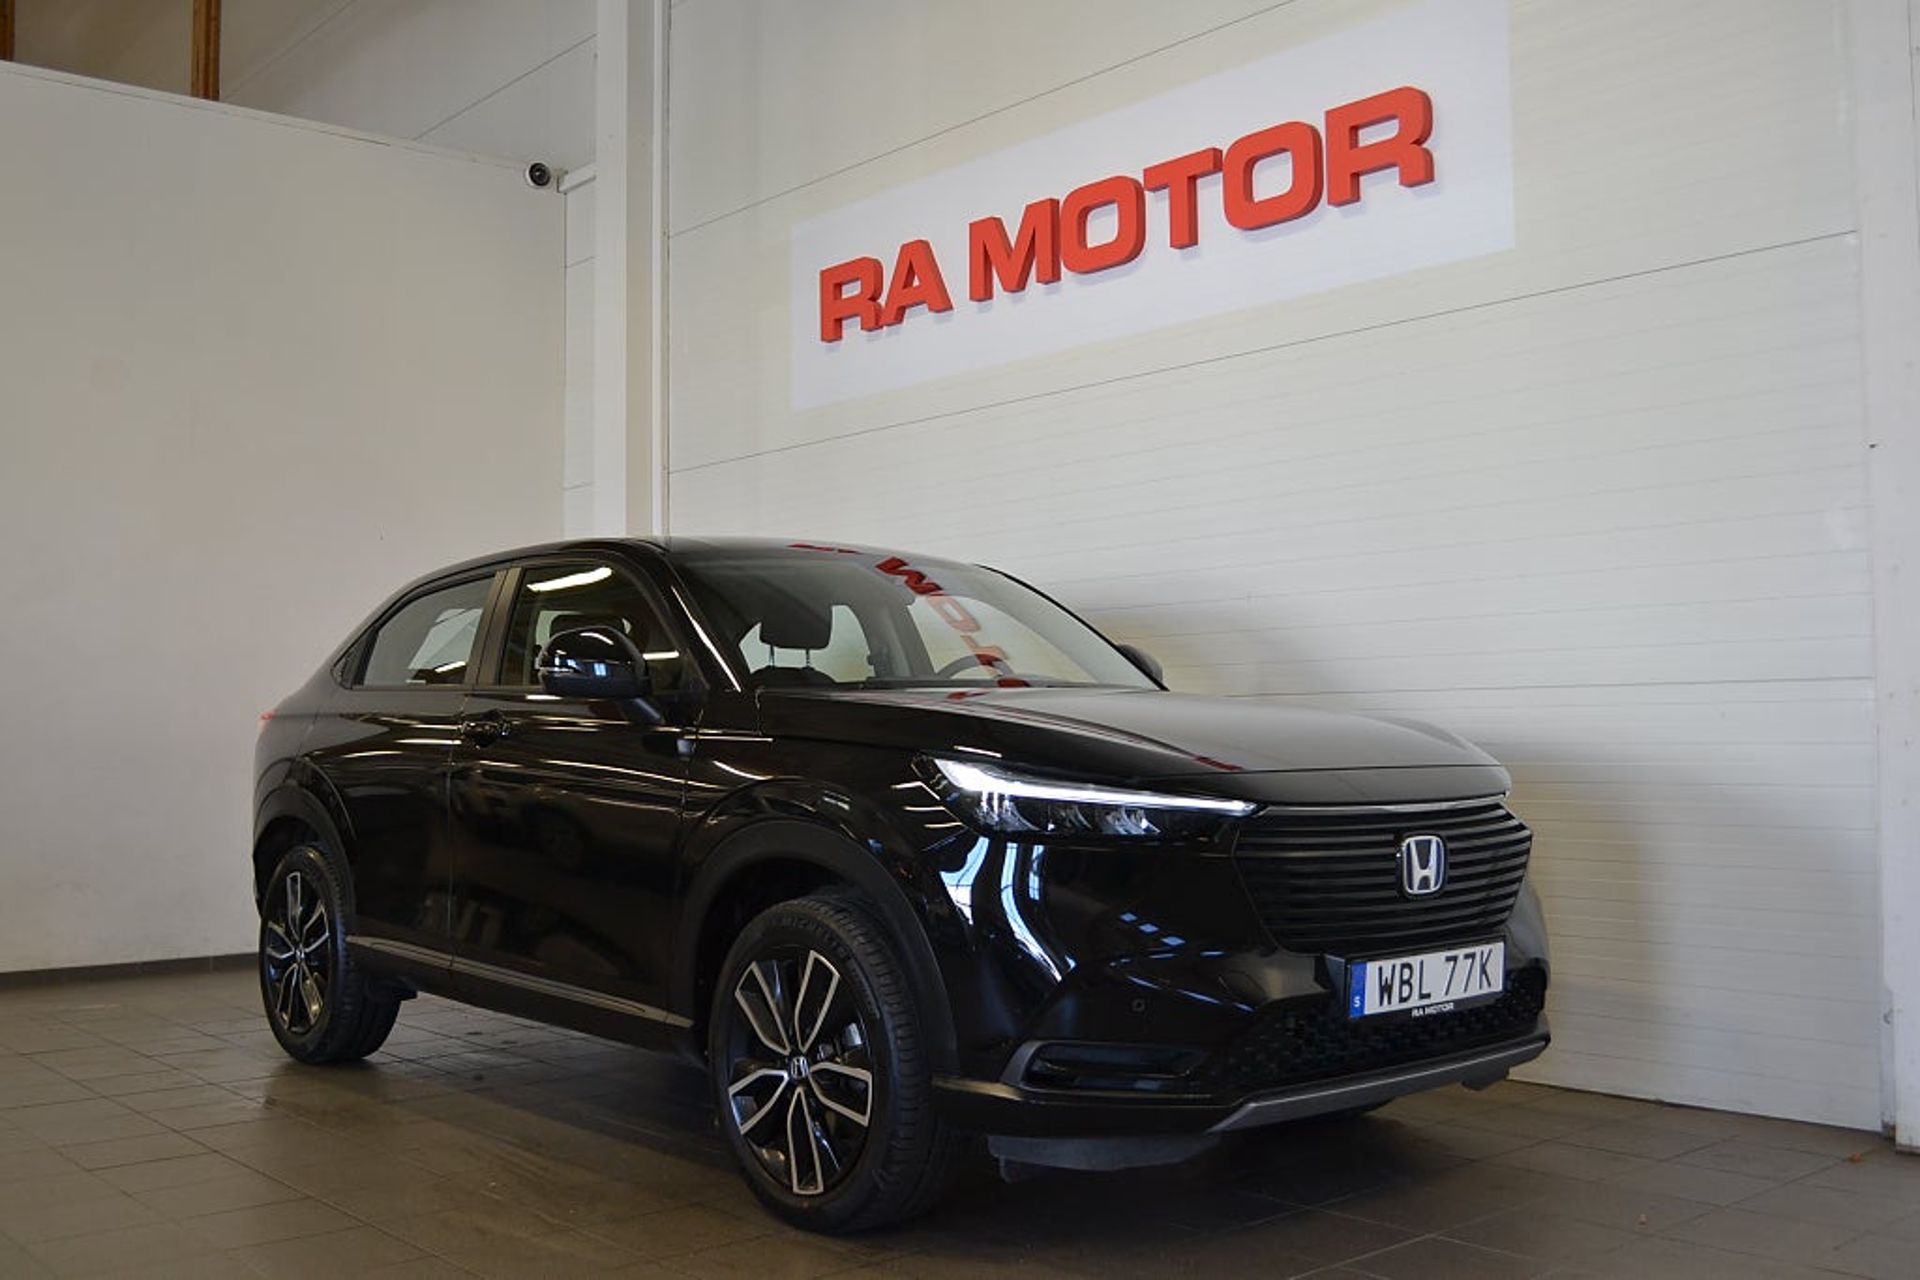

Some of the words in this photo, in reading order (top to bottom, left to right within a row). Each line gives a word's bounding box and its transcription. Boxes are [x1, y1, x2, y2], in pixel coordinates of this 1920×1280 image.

[819, 239, 954, 343] RA
[969, 86, 1434, 302] MOTOR
[1353, 996, 1361, 1008] S
[1378, 959, 1431, 1007] WBL
[1444, 948, 1493, 997] 77K
